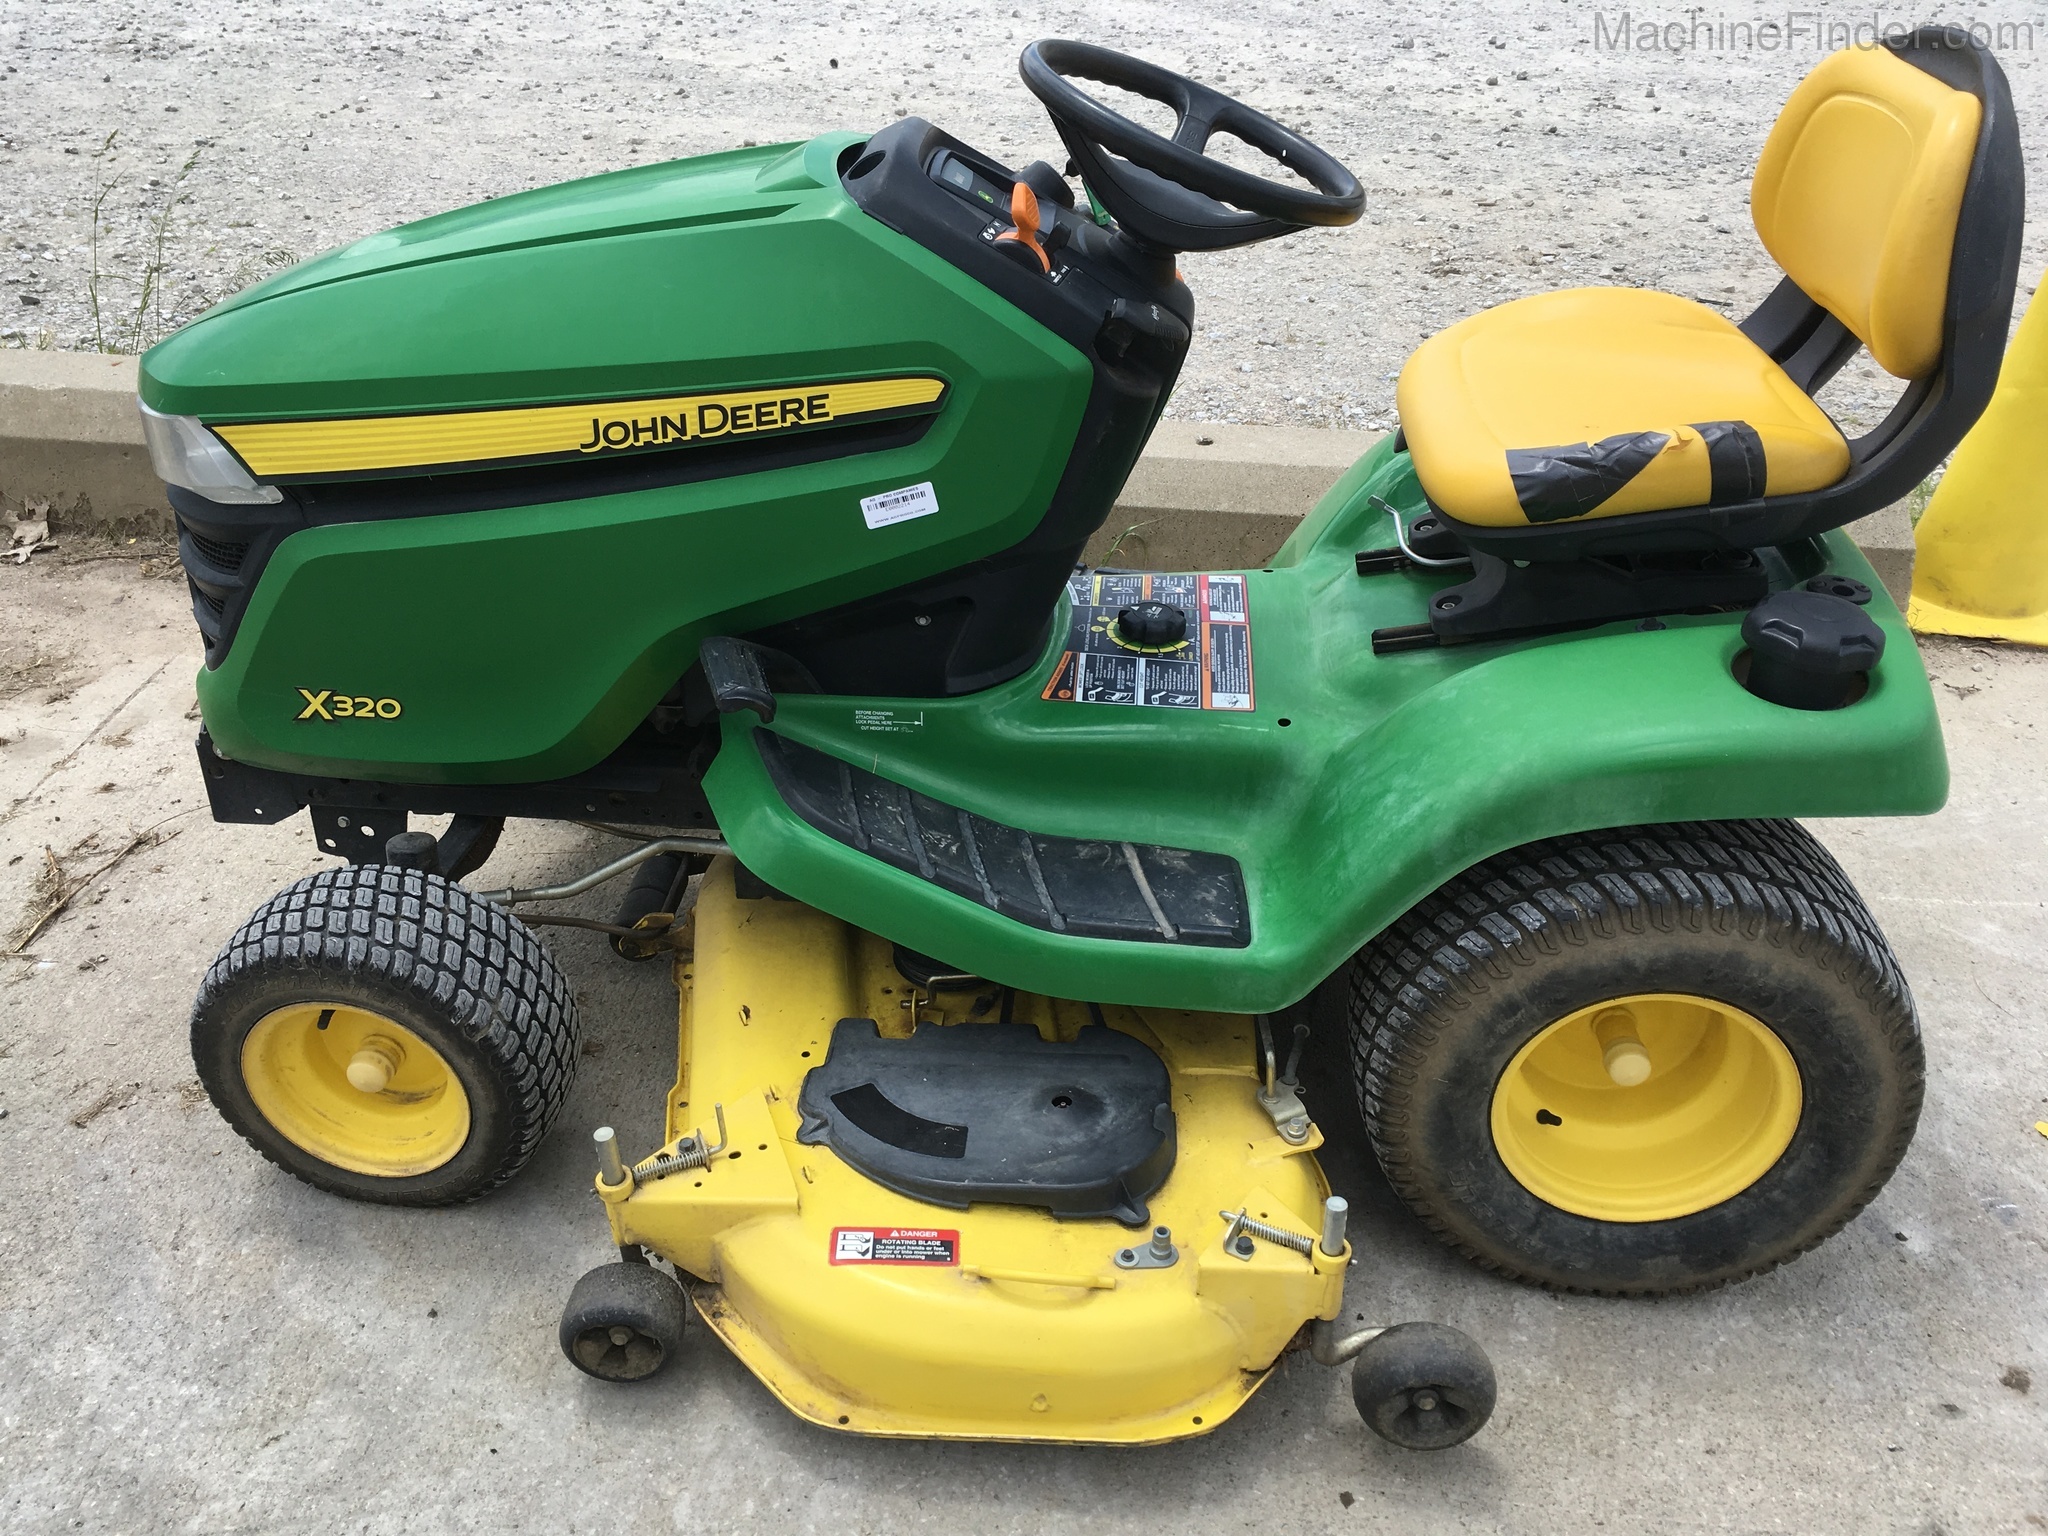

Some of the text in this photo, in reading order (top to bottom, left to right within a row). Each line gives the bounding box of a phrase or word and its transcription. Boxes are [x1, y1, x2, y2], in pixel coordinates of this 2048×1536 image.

[579, 393, 831, 451] JOHN DEERE
[296, 688, 402, 720] X320
[900, 1230, 938, 1238] DANGER
